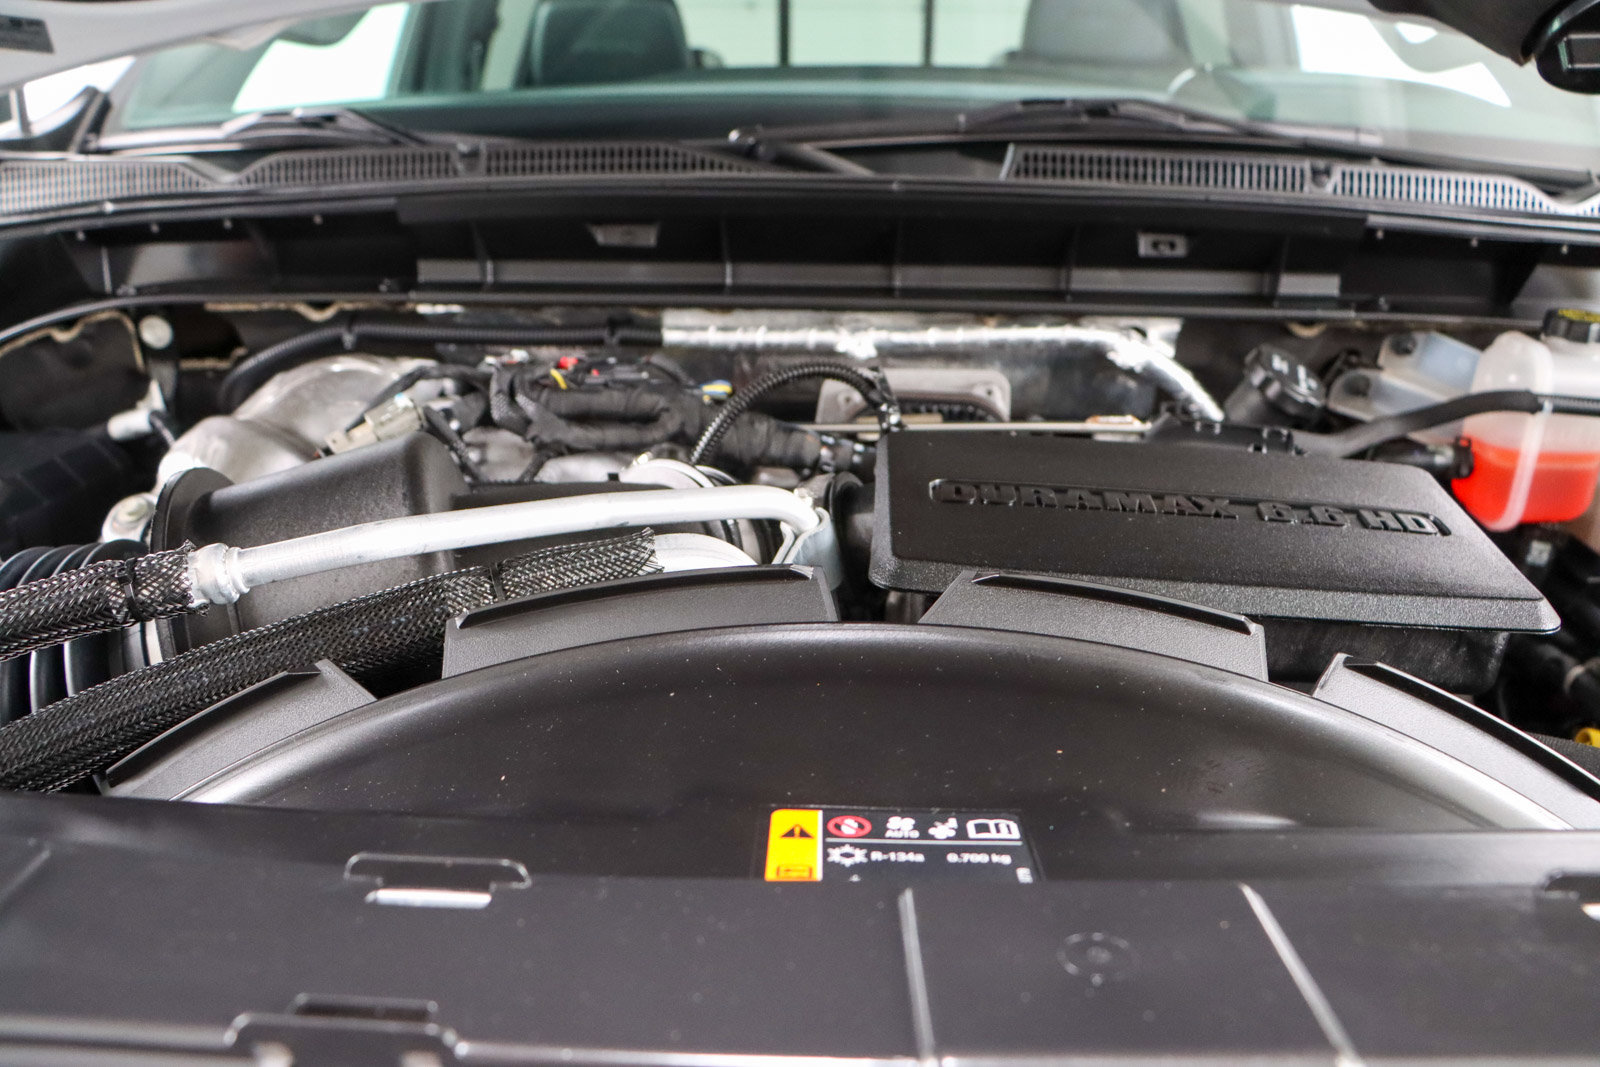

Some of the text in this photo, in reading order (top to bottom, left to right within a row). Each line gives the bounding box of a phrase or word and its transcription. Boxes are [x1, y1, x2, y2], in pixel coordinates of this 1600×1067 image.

[930, 480, 1440, 535] DURAMAX 6.6 HD
[884, 829, 920, 839] AUTO
[870, 850, 925, 863] R-134a
[991, 853, 1012, 866] kg
